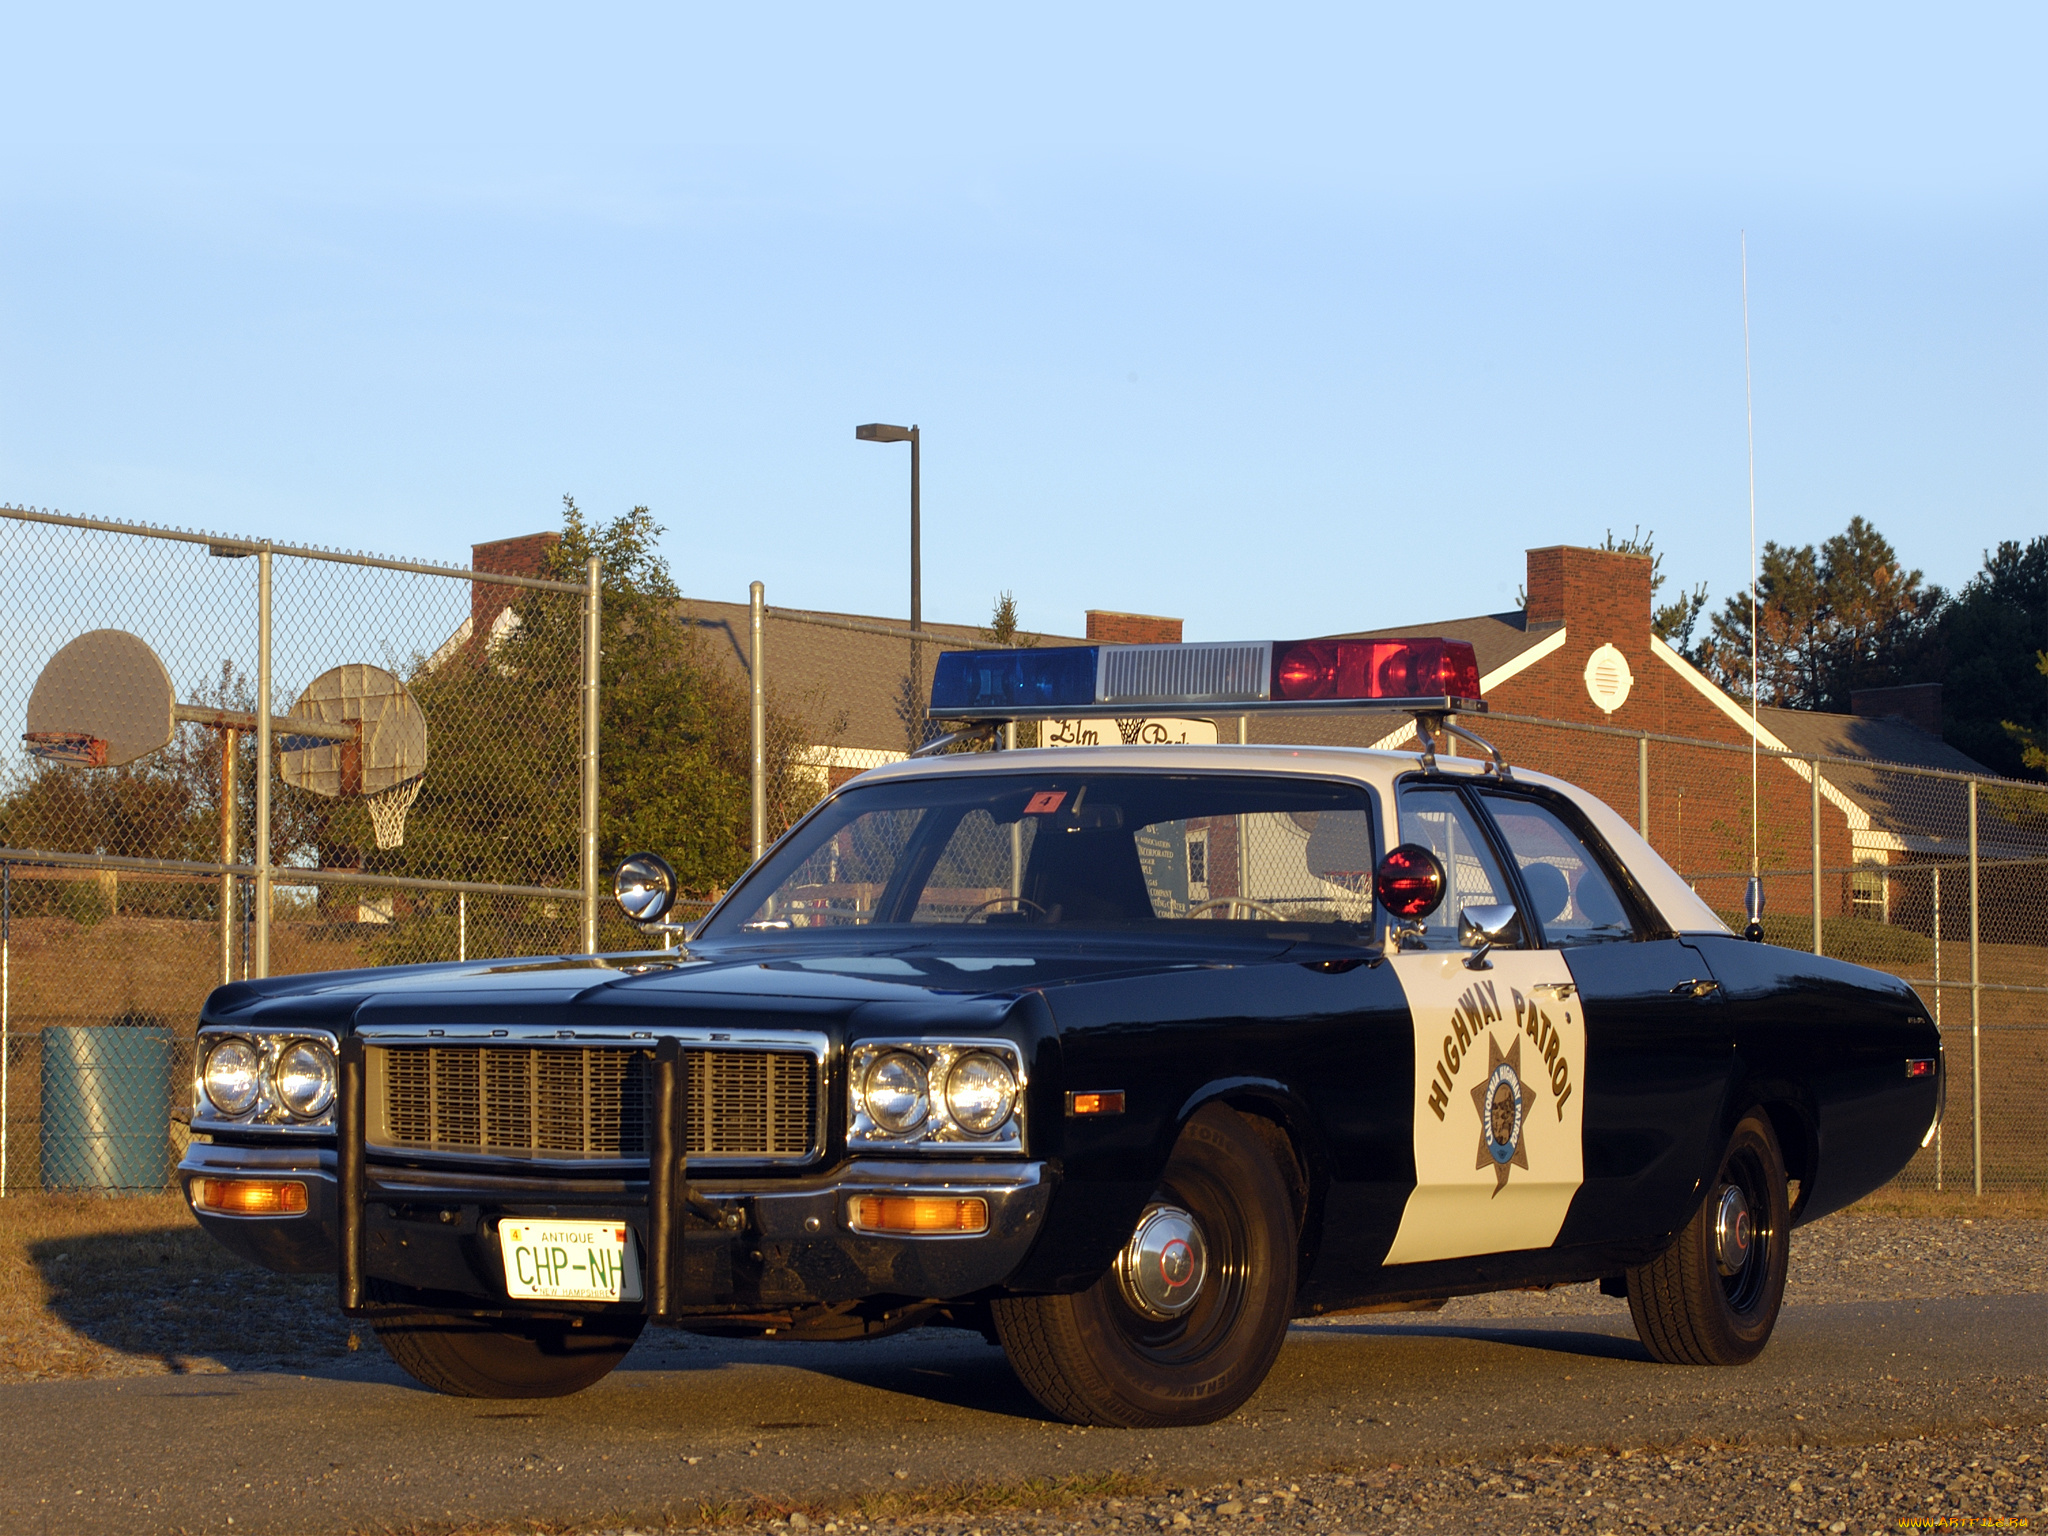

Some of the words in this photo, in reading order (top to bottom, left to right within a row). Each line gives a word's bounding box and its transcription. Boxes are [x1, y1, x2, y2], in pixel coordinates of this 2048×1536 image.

[1050, 719, 1100, 746] Elm
[427, 1028, 731, 1042] DODGE
[1428, 980, 1502, 1122] HIGHWAY
[1510, 987, 1573, 1122] PATROL
[1499, 1065, 1521, 1100] HIGHWAY
[1484, 1071, 1500, 1146] CALIFORNIA
[1509, 1103, 1522, 1149] PATROL
[541, 1232, 595, 1243] ANTIQUE
[515, 1246, 627, 1289] CHP-NH
[539, 1288, 558, 1297] NEW
[562, 1289, 610, 1298] HAMPSHIRE
